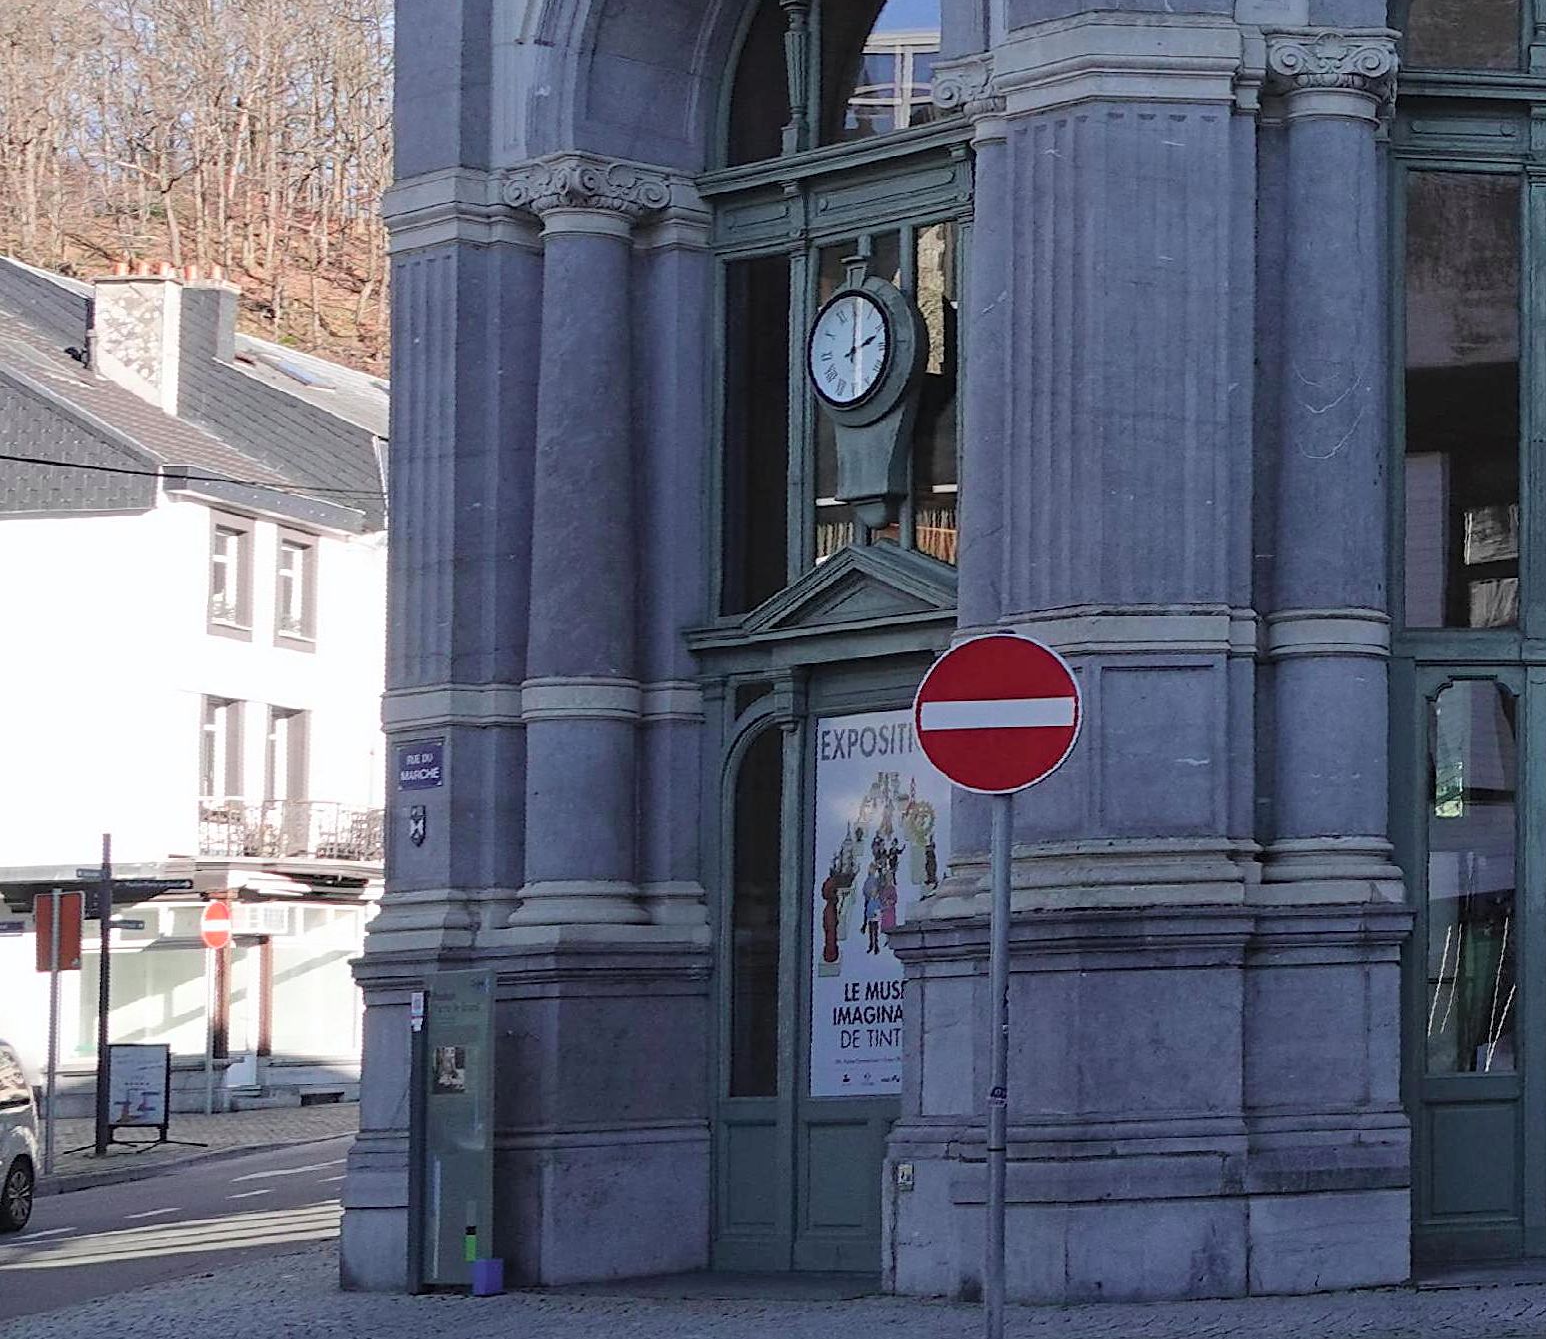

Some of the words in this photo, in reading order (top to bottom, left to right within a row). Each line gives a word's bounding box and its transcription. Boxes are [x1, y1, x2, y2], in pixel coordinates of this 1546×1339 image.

[821, 723, 915, 761] EXPOSITI
[844, 982, 860, 1002] LE
[841, 1029, 860, 1049] DE
[867, 1028, 902, 1048] TINT
